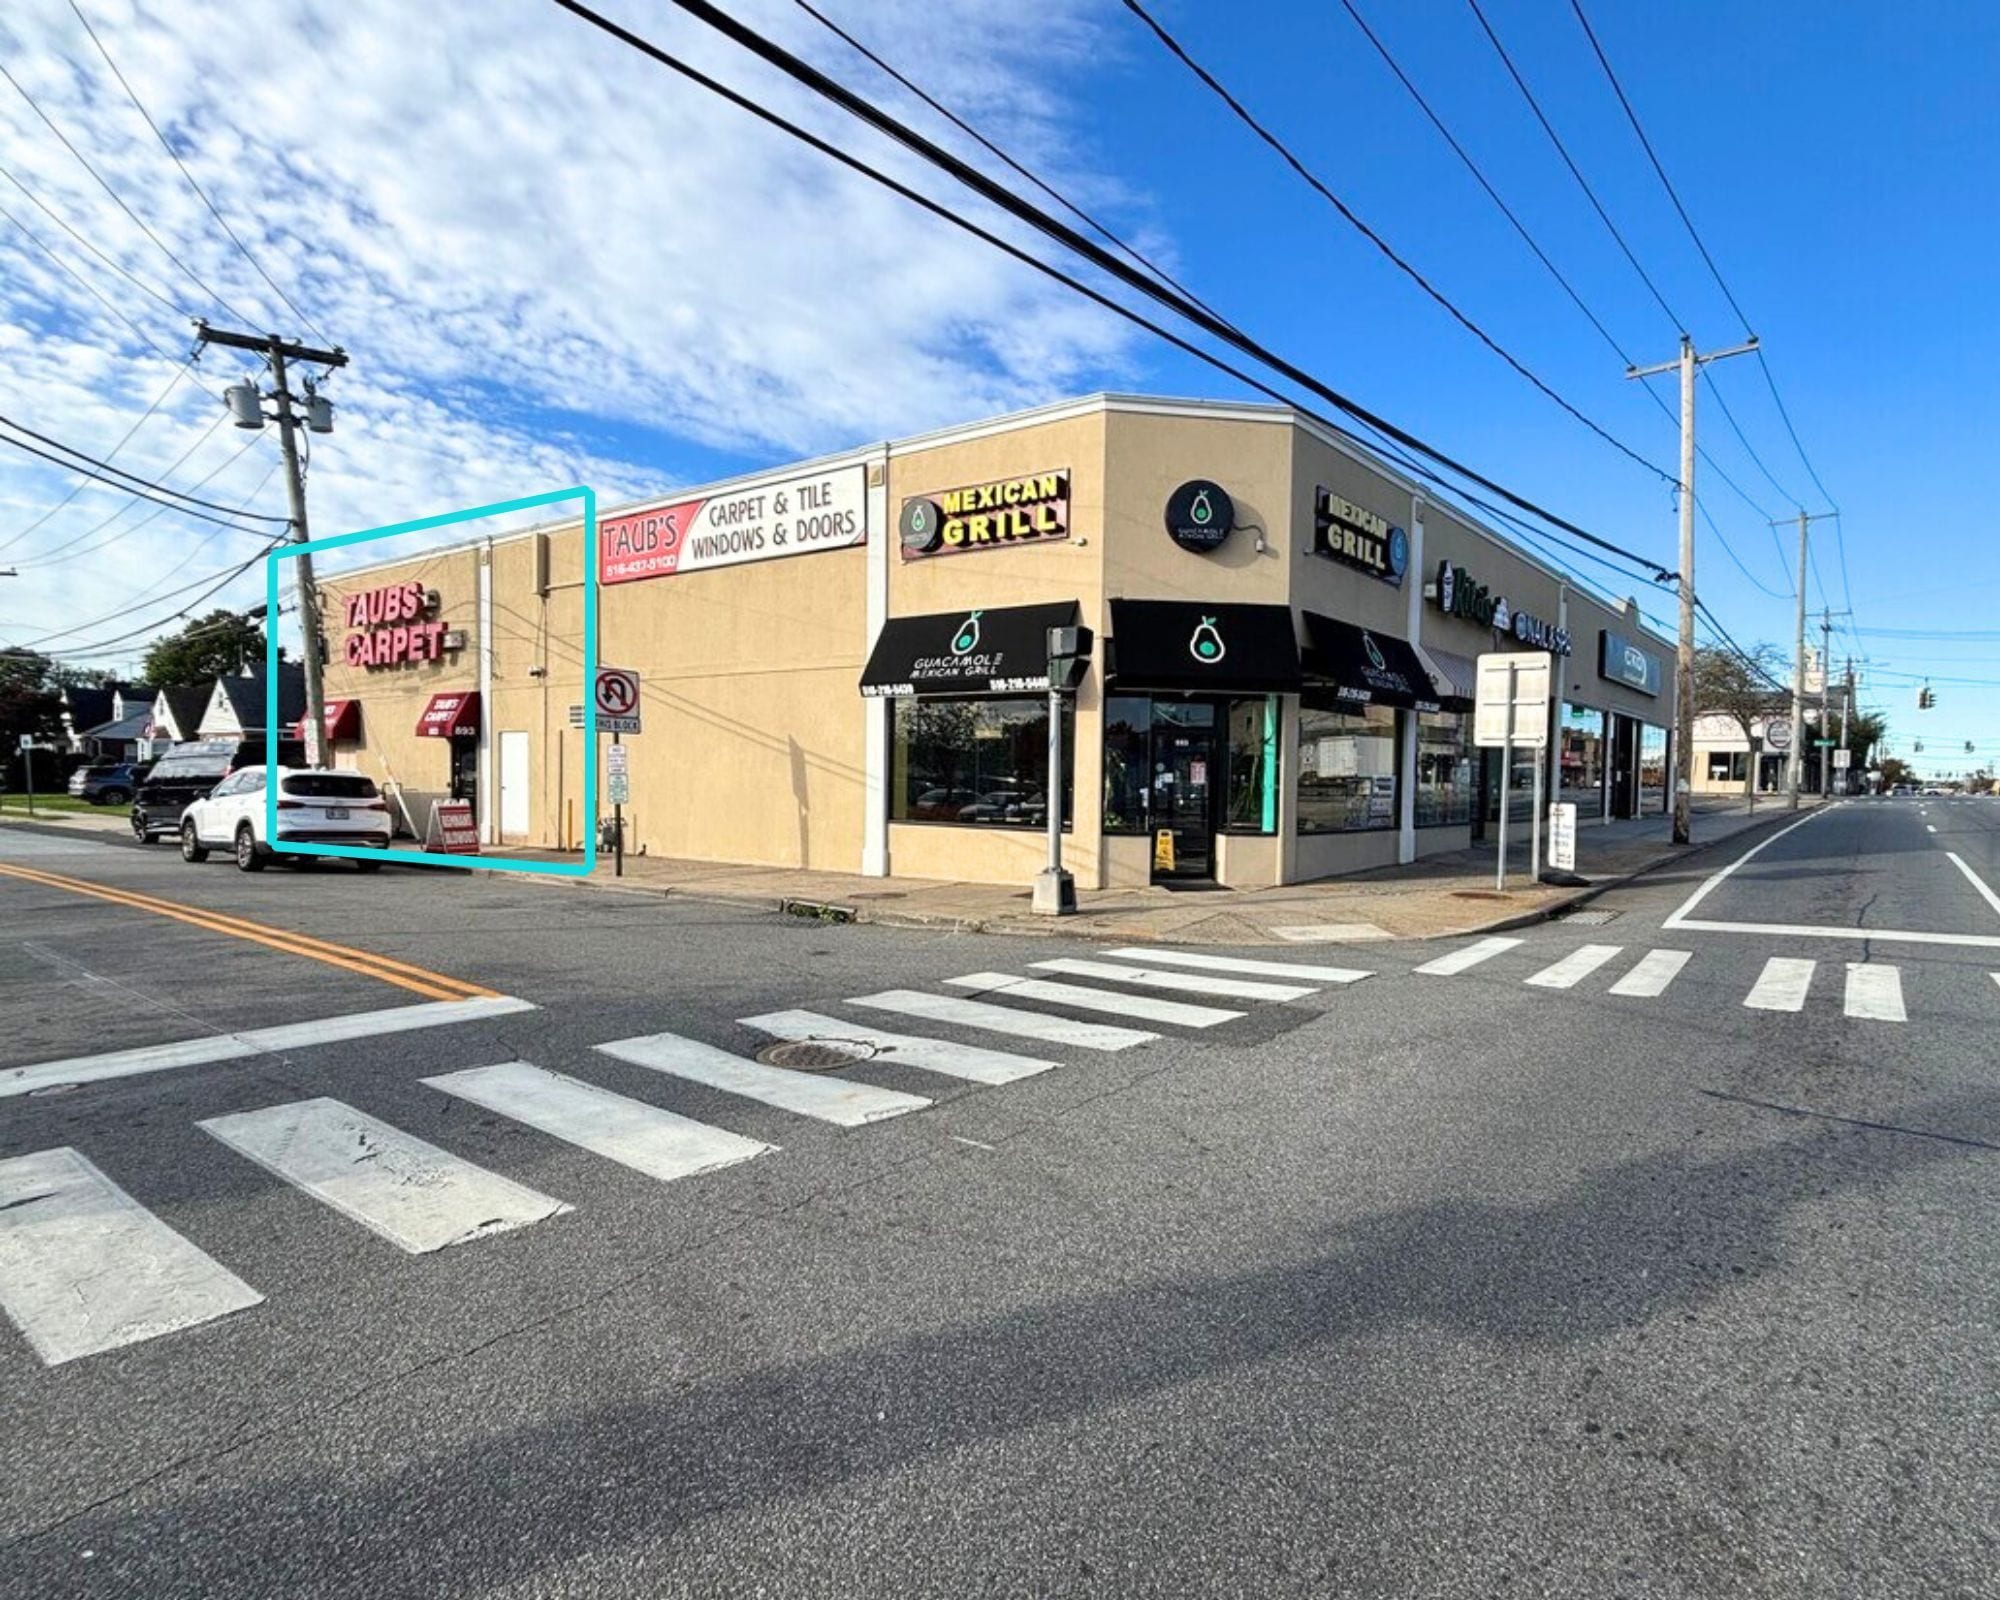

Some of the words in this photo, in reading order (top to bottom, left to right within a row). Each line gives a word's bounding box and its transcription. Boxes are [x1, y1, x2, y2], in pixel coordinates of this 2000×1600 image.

[709, 496, 766, 526] CARPET
[773, 492, 788, 515] &
[797, 482, 832, 511] TILE
[943, 474, 1058, 514] MEXICAN
[604, 515, 676, 557] TAUB'S
[691, 526, 765, 559] WINDOWS
[772, 522, 788, 545] &
[796, 510, 855, 542] DOORS
[942, 505, 1056, 546] GRILL
[1328, 493, 1387, 540] MEXICAN
[1327, 523, 1386, 570] GRILL
[345, 622, 448, 667] CARPET
